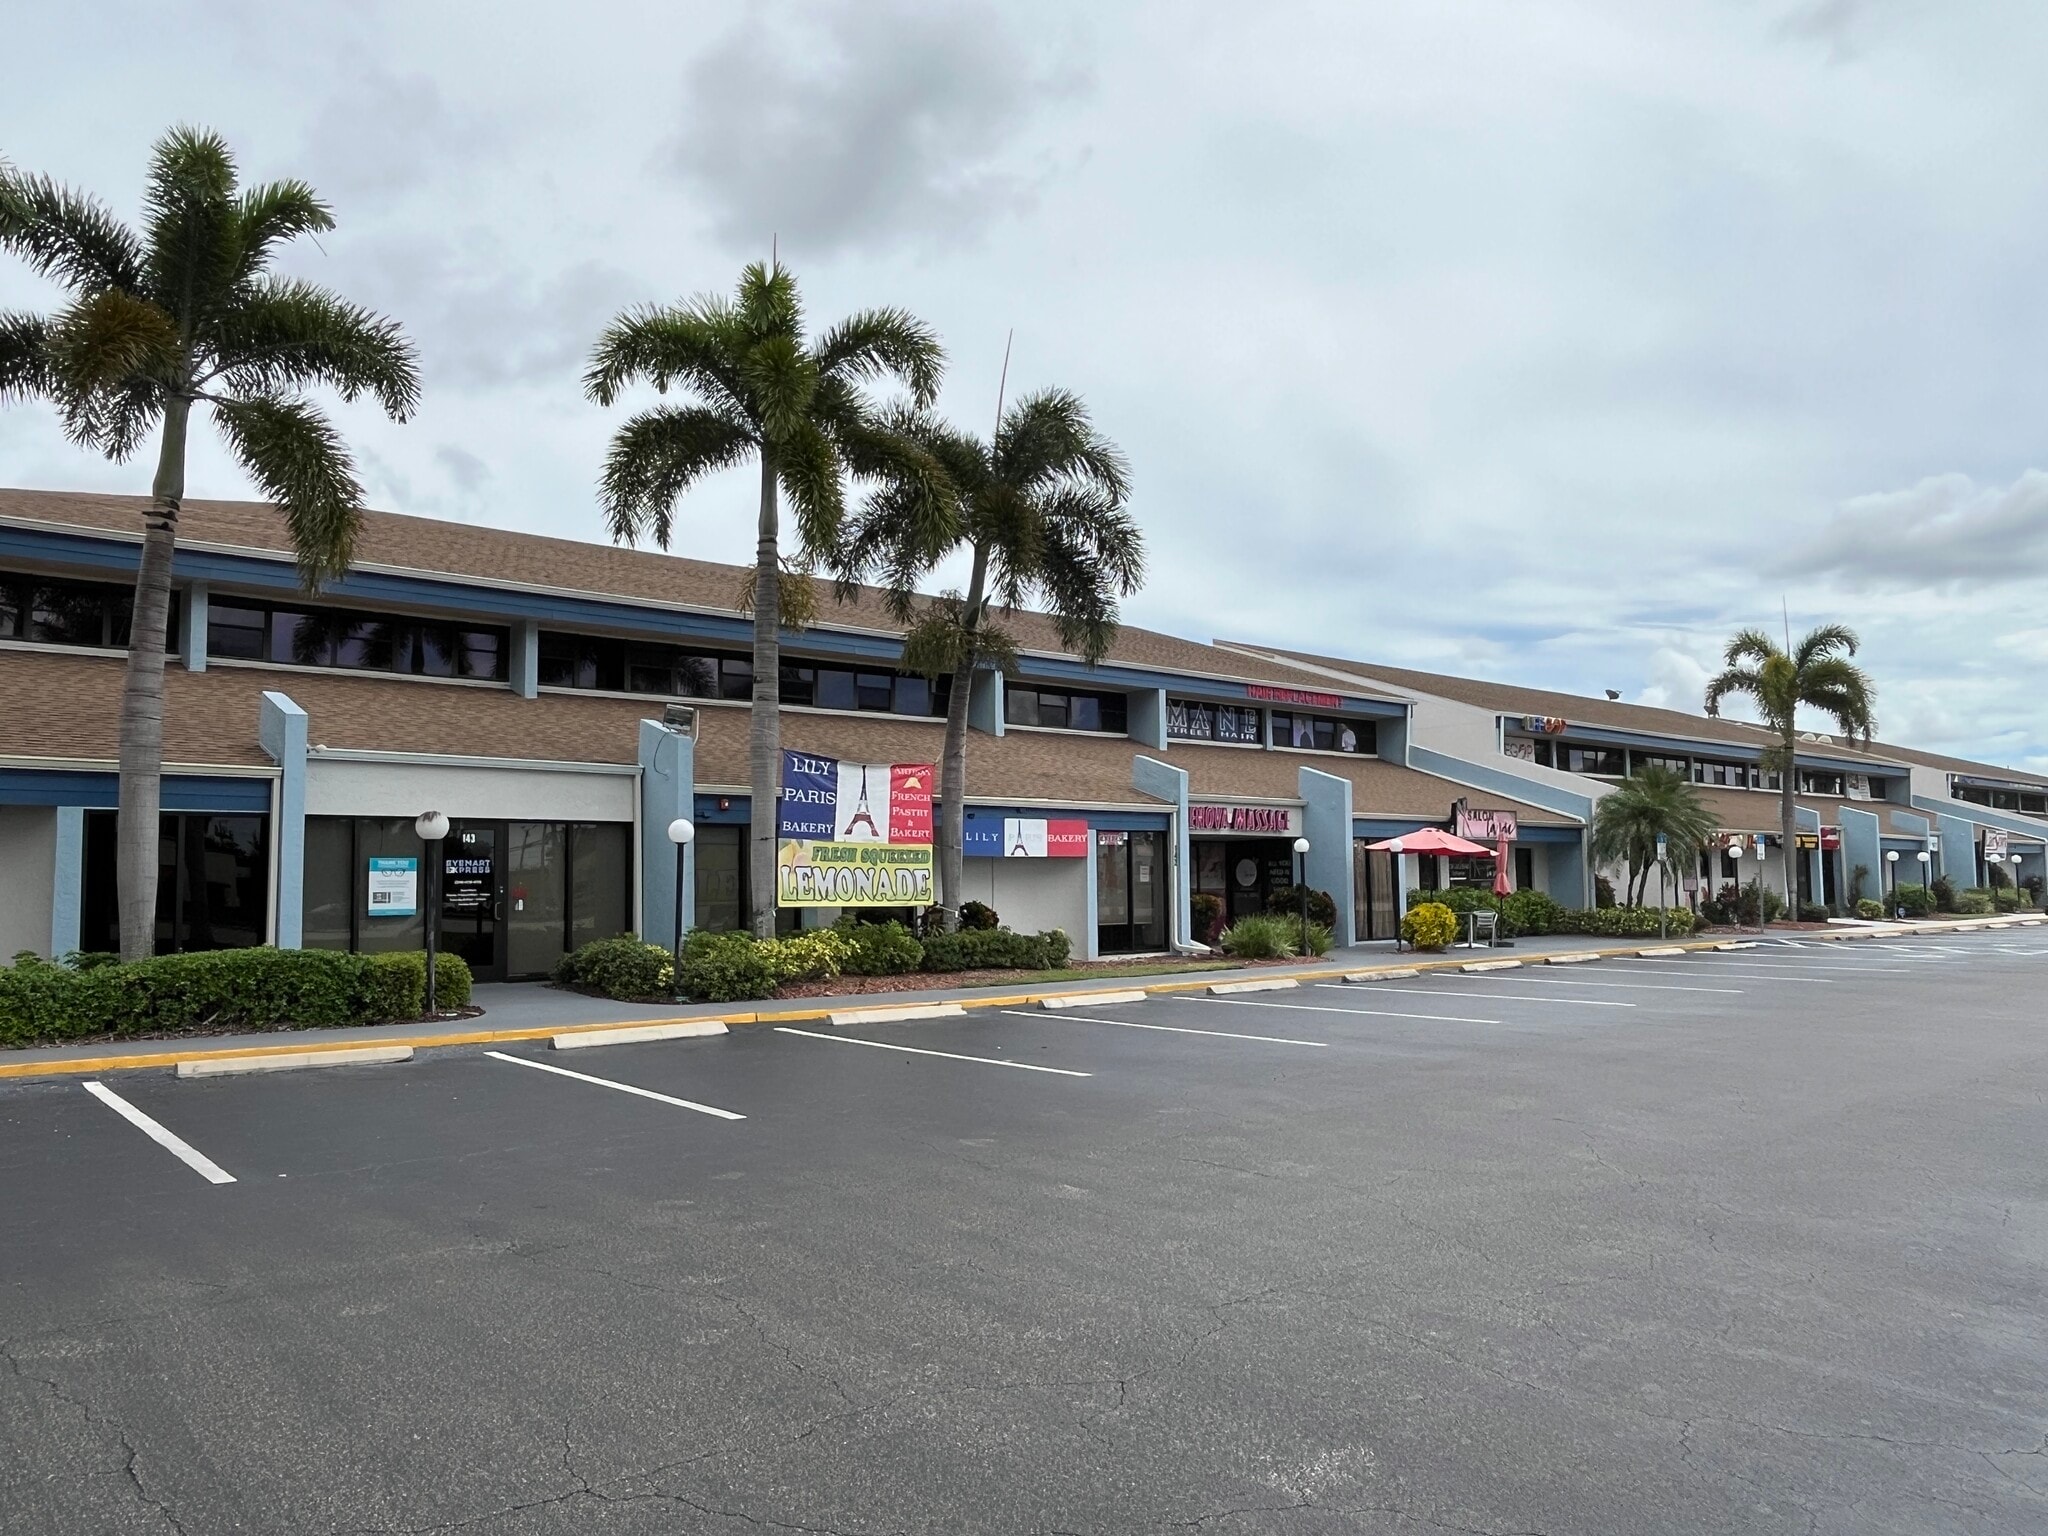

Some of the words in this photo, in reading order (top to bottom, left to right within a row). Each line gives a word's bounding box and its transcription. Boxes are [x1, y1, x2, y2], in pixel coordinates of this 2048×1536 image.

[1220, 731, 1255, 741] HAIR
[792, 757, 831, 776] LILY
[784, 788, 836, 805] PARIS
[891, 790, 931, 802] FRENCH
[1467, 810, 1494, 821] SALON
[782, 820, 834, 834] BAKERY
[890, 827, 930, 838] BAKERY
[462, 833, 476, 843] 143
[965, 832, 999, 842] LILY
[1048, 834, 1087, 843] BAKERY
[811, 846, 857, 861] FRESH
[860, 848, 930, 866] SQUEEZED
[780, 864, 931, 901] LEMONADE
